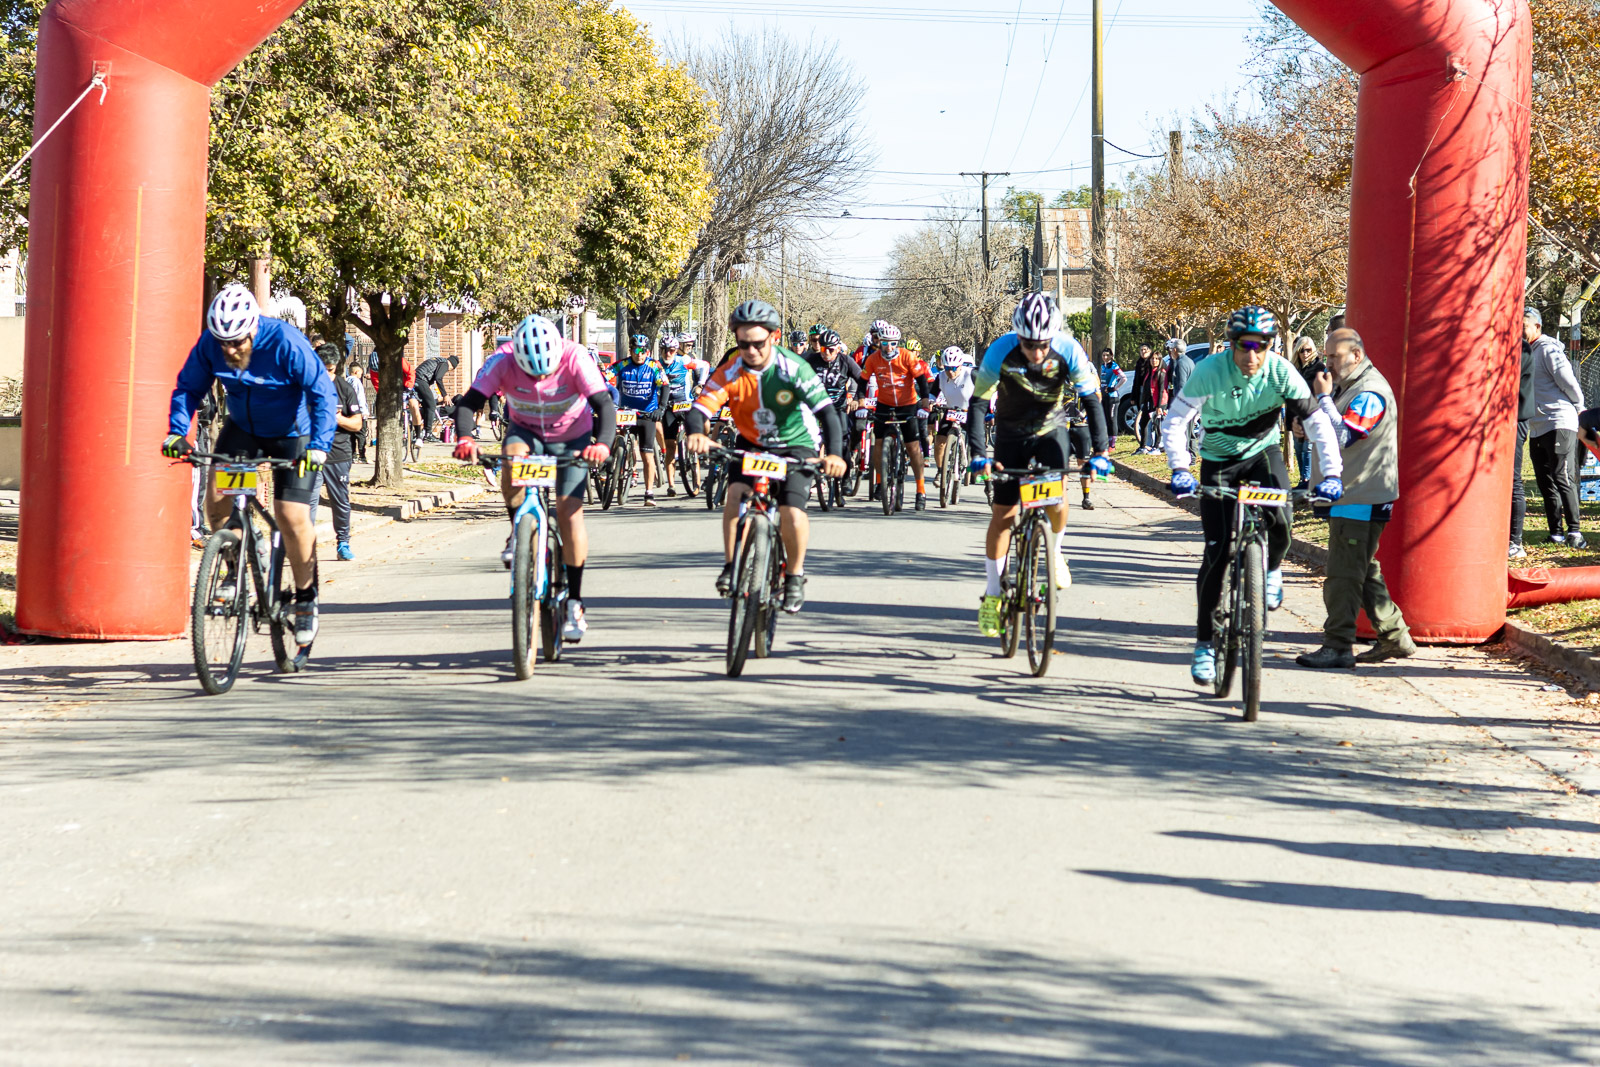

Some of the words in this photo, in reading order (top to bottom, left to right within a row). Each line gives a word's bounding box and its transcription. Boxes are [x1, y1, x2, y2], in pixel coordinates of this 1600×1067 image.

[619, 414, 635, 423] 137
[519, 464, 550, 479] 145
[752, 460, 779, 472] 116
[226, 472, 246, 488] 71
[1032, 484, 1050, 499] 14
[1246, 491, 1281, 501] 180
